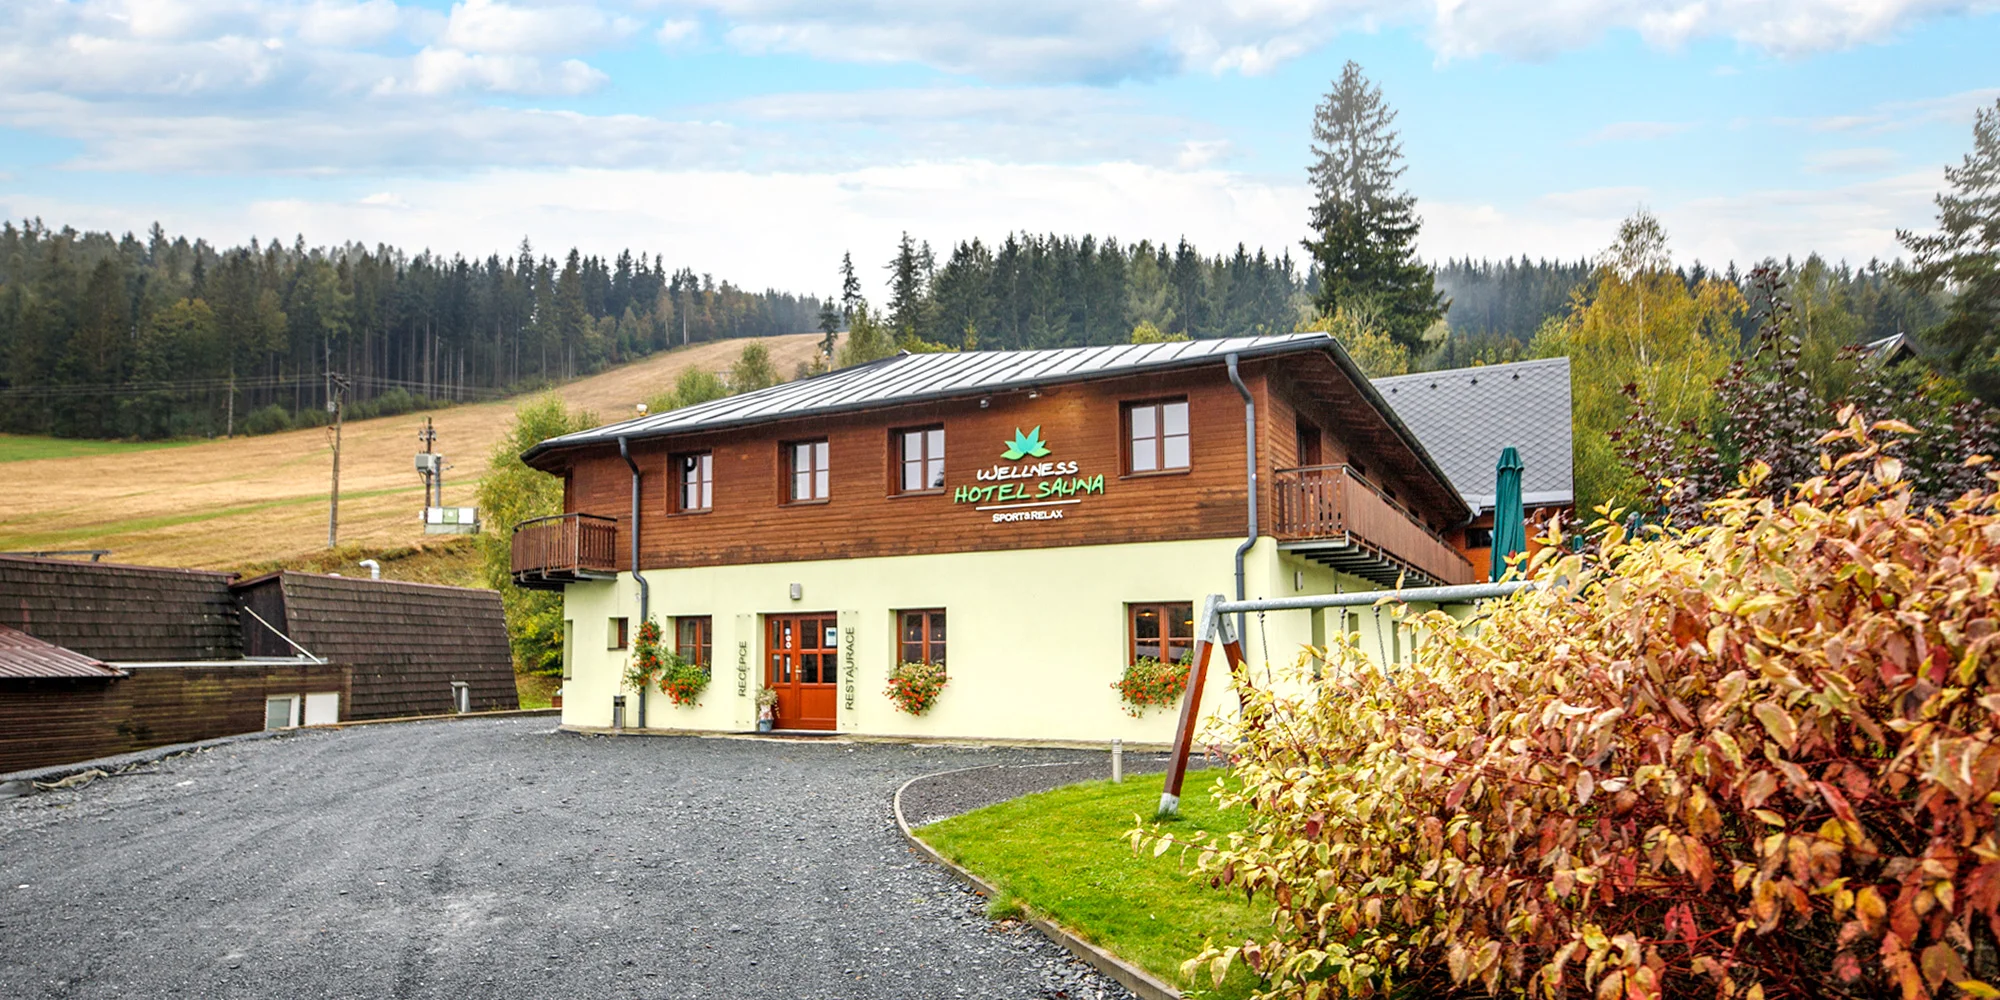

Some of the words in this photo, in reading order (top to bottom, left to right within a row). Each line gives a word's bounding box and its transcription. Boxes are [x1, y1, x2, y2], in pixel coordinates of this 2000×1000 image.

[976, 461, 1079, 480] WELLNESS
[954, 483, 1031, 504] HOTEL
[1035, 473, 1105, 499] SAUNA
[992, 509, 1063, 523] SPORT&RELAX
[845, 626, 855, 710] RESTAURACE
